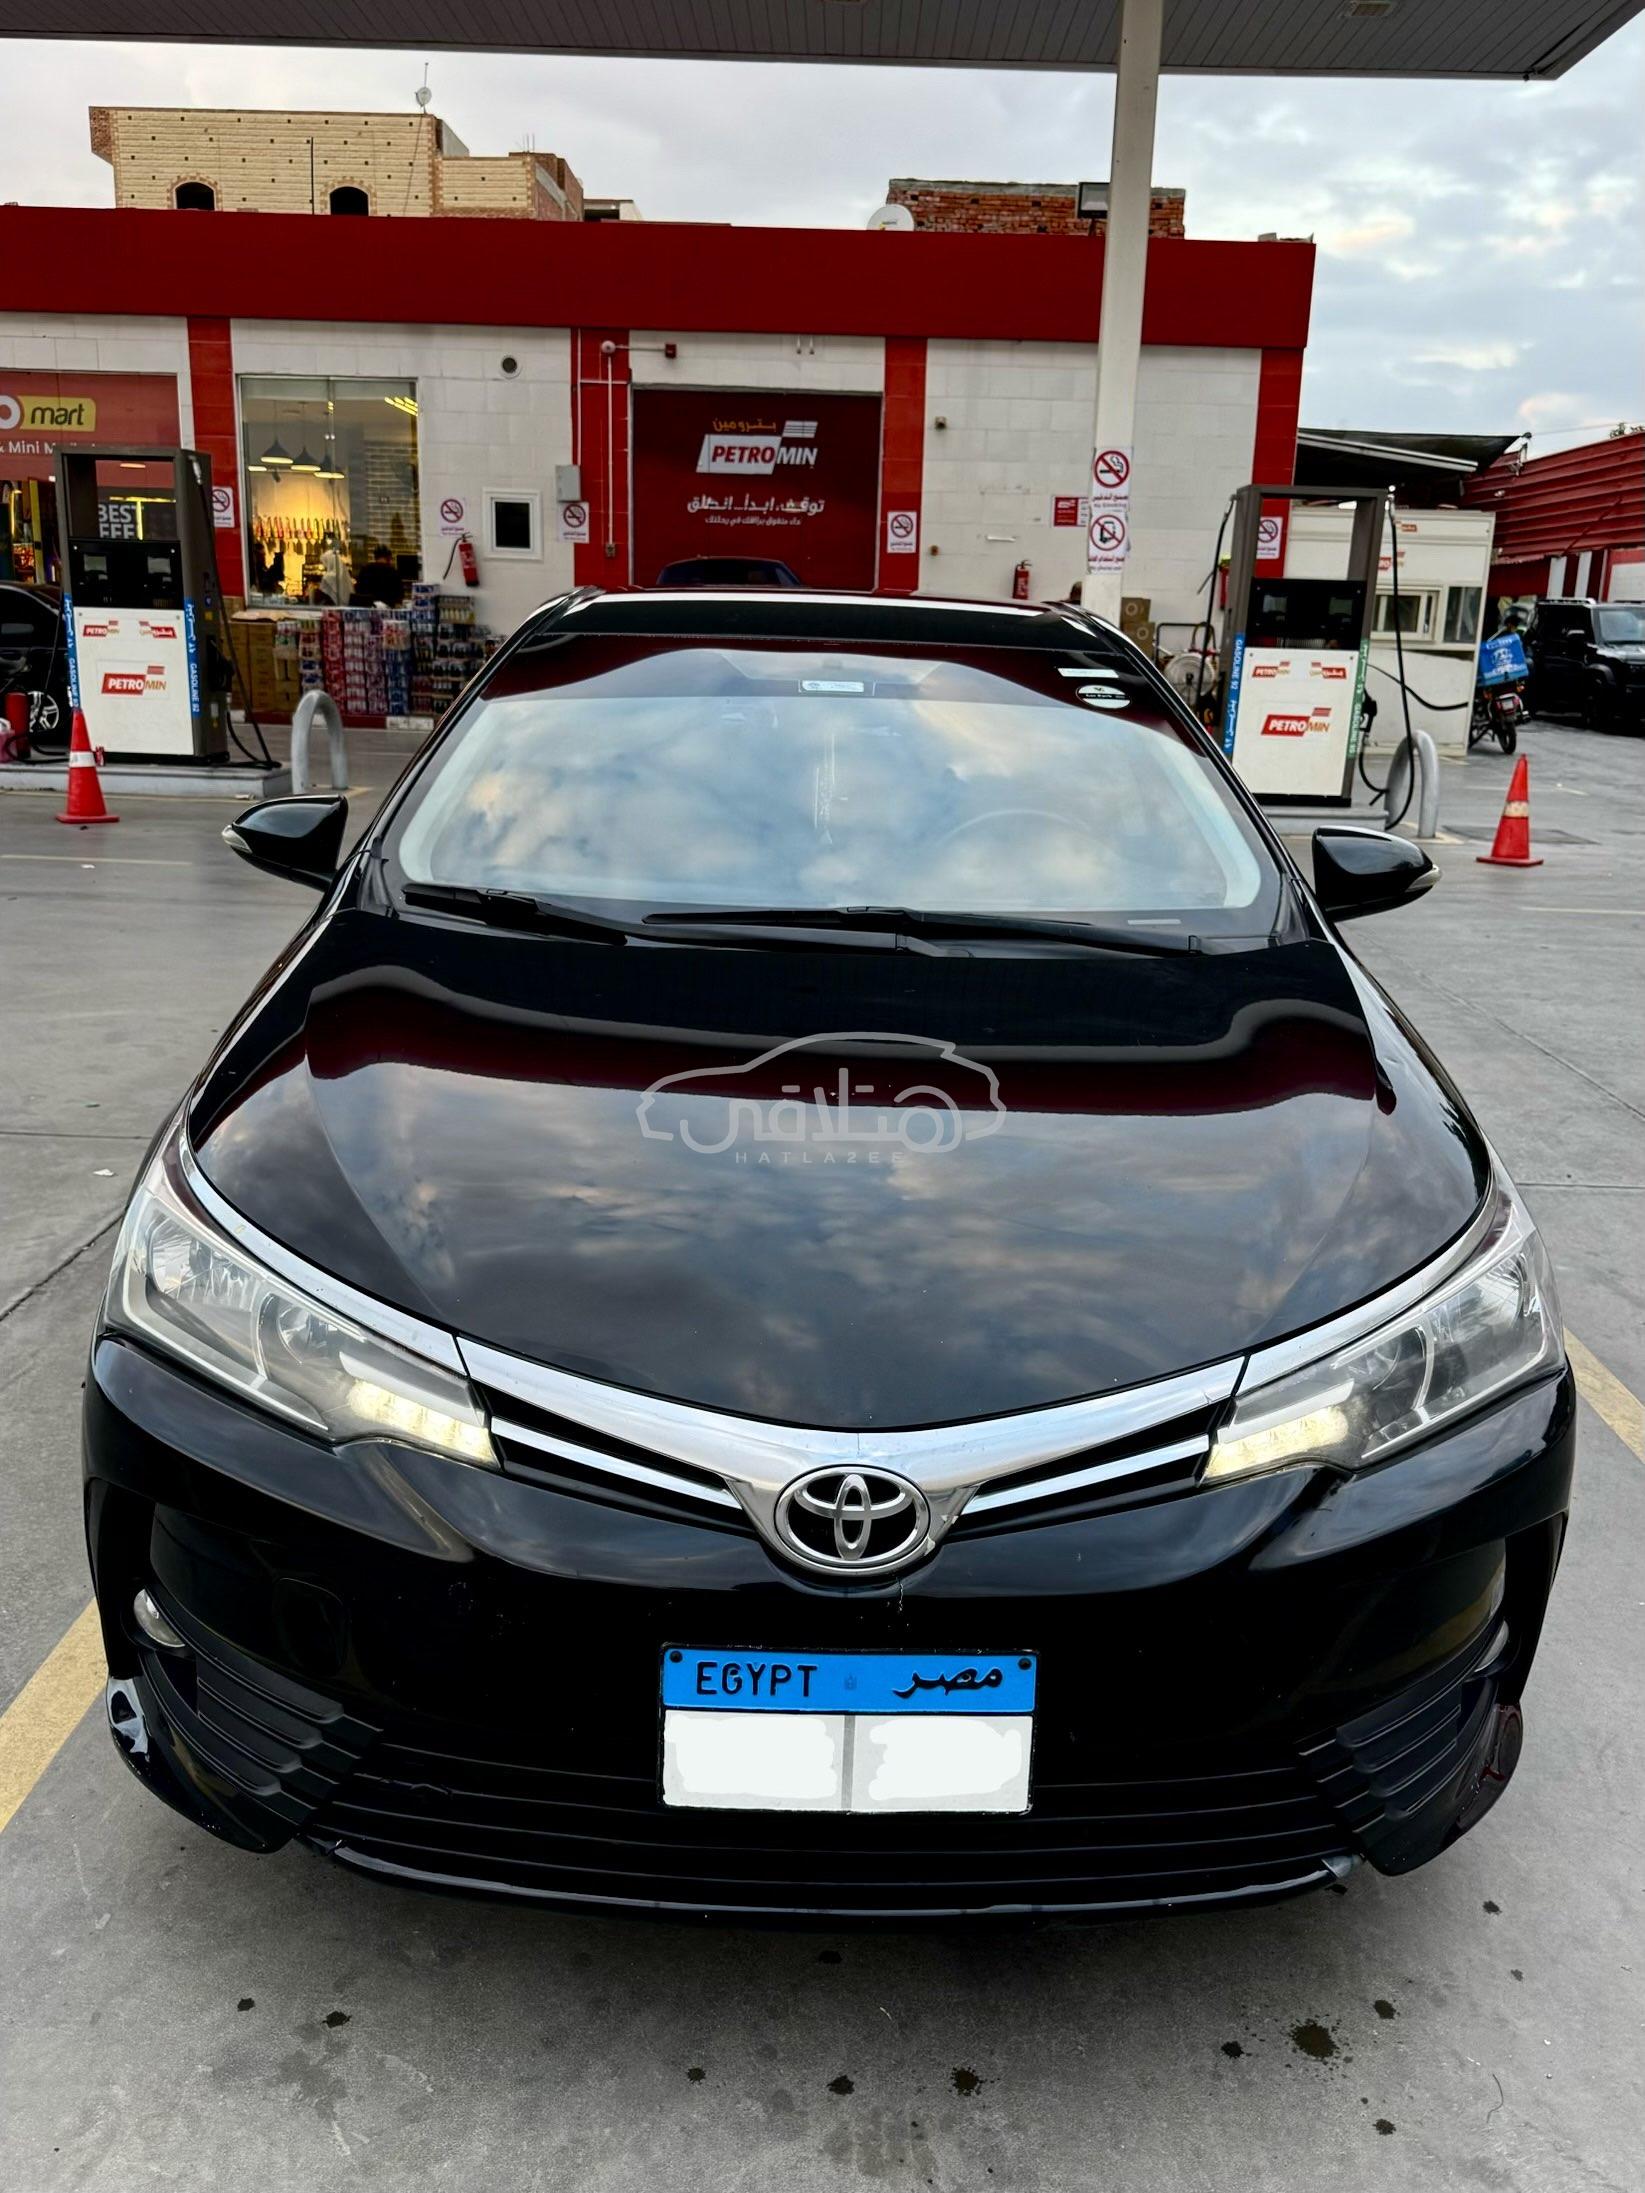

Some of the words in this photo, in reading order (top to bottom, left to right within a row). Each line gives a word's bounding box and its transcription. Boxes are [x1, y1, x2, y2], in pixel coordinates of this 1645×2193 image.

[31, 404, 85, 425] mart
[712, 417, 776, 432] بترومين
[9, 441, 39, 454] Mini
[711, 446, 818, 465] PETROMIN
[1231, 639, 1243, 679] GASOLINE
[108, 678, 167, 691] PETROMIN
[190, 663, 199, 702] GASOLINE
[1269, 719, 1329, 733] PETROMIN
[696, 1661, 819, 1698] EGYPT
[891, 1667, 1004, 1700] مصر
